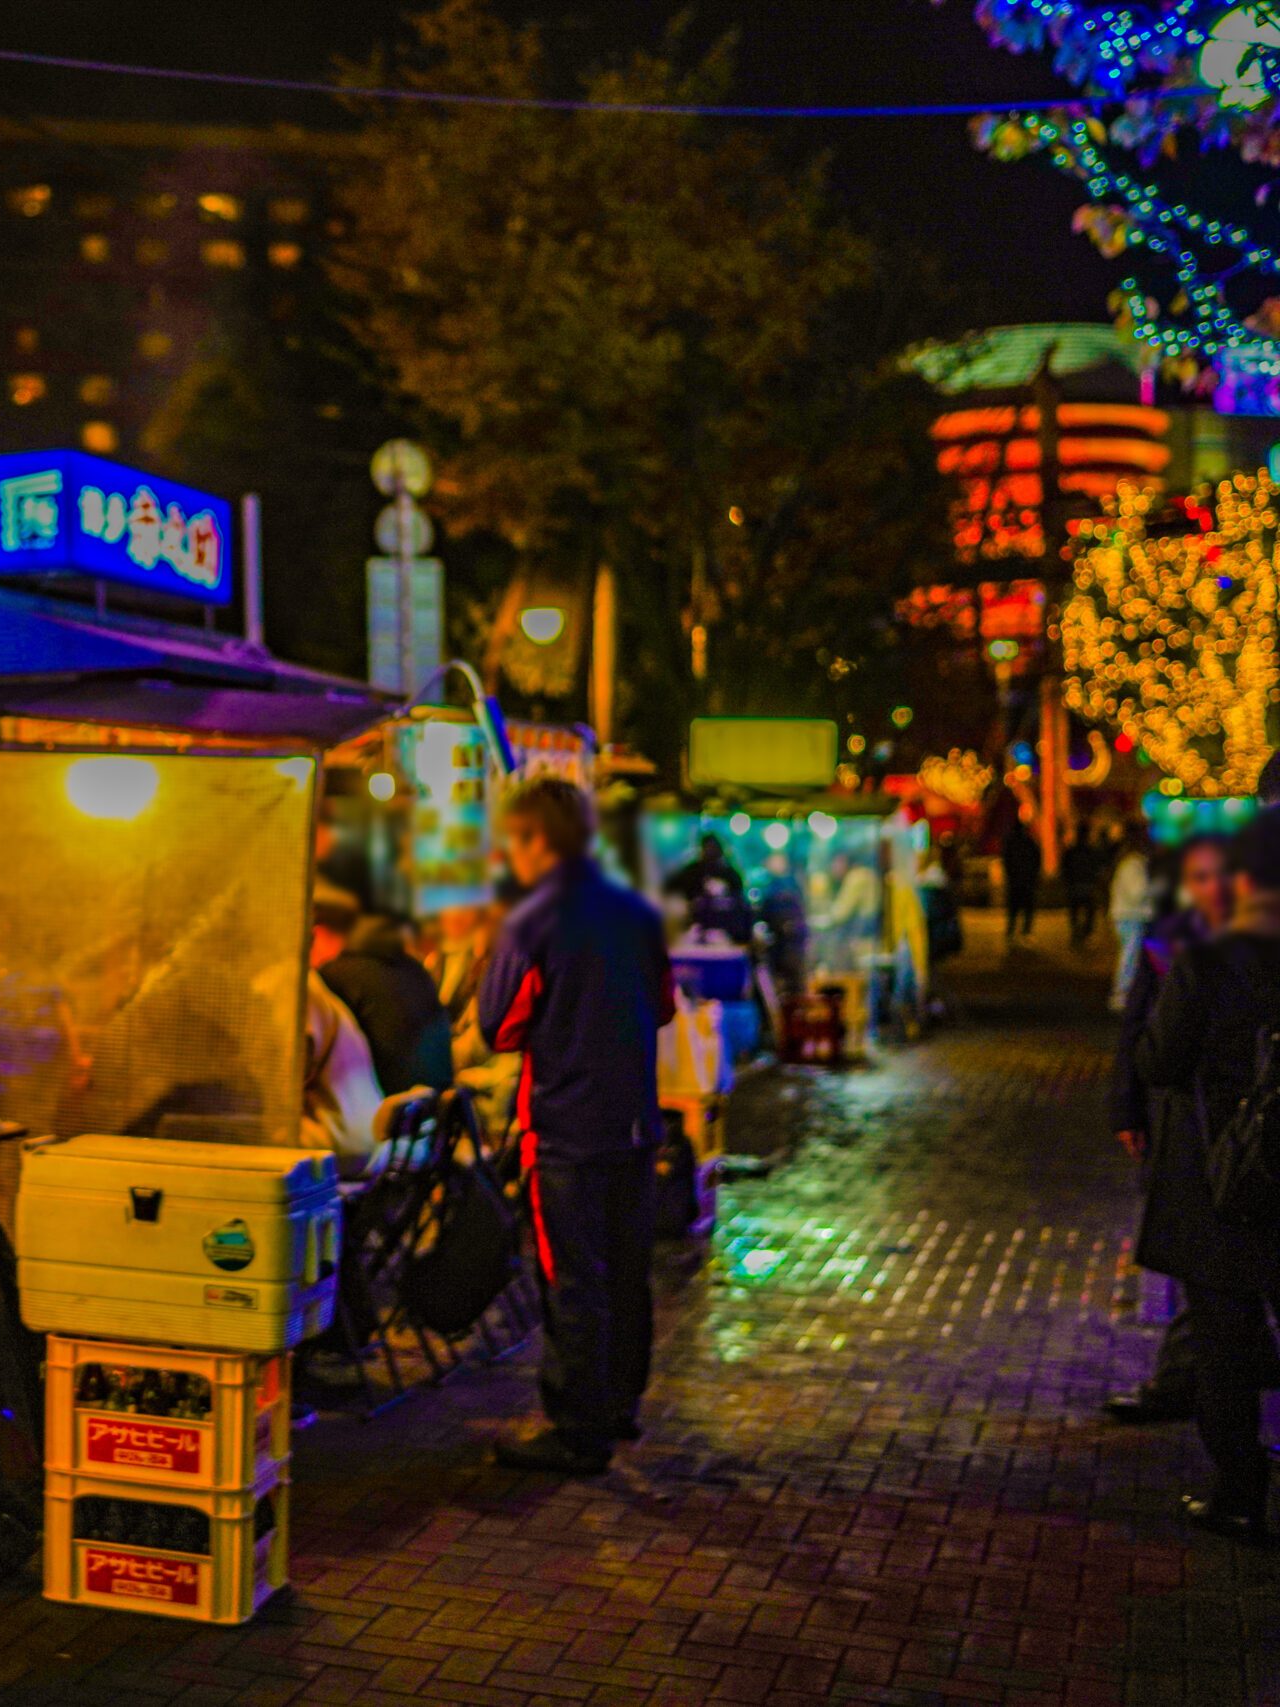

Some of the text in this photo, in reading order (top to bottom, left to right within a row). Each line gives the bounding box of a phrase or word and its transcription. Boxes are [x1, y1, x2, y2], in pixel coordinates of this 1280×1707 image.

[89, 1422, 196, 1452] アサヒビール
[88, 1553, 195, 1585] アサヒビール
